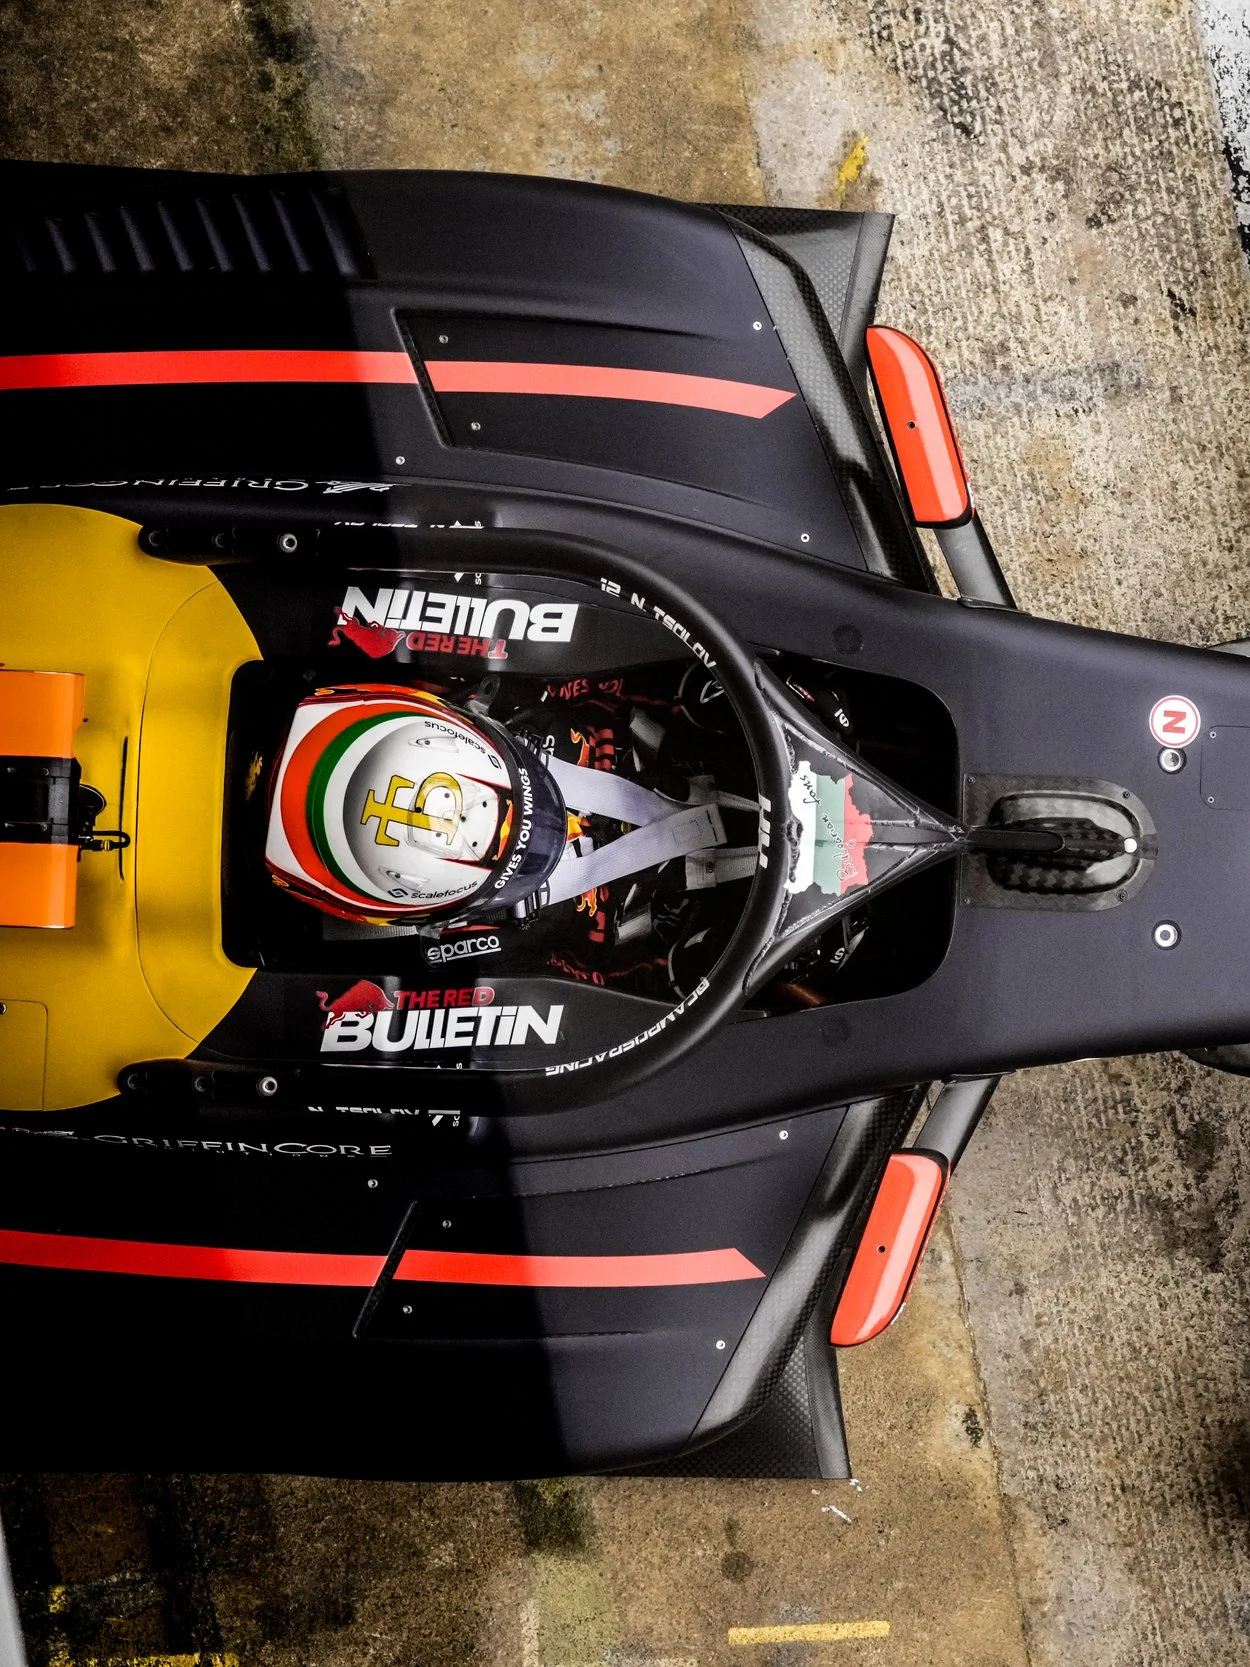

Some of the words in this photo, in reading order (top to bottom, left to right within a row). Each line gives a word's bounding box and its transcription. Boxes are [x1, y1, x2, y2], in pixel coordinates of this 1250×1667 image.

[424, 720, 486, 755] scalefocus
[518, 767, 534, 815] WINGS
[517, 817, 533, 850] YOU
[494, 853, 522, 890] GIVES
[410, 880, 478, 900] scalefocus
[427, 935, 500, 968] sparco
[393, 990, 440, 1010] THE
[443, 986, 495, 1007] RED
